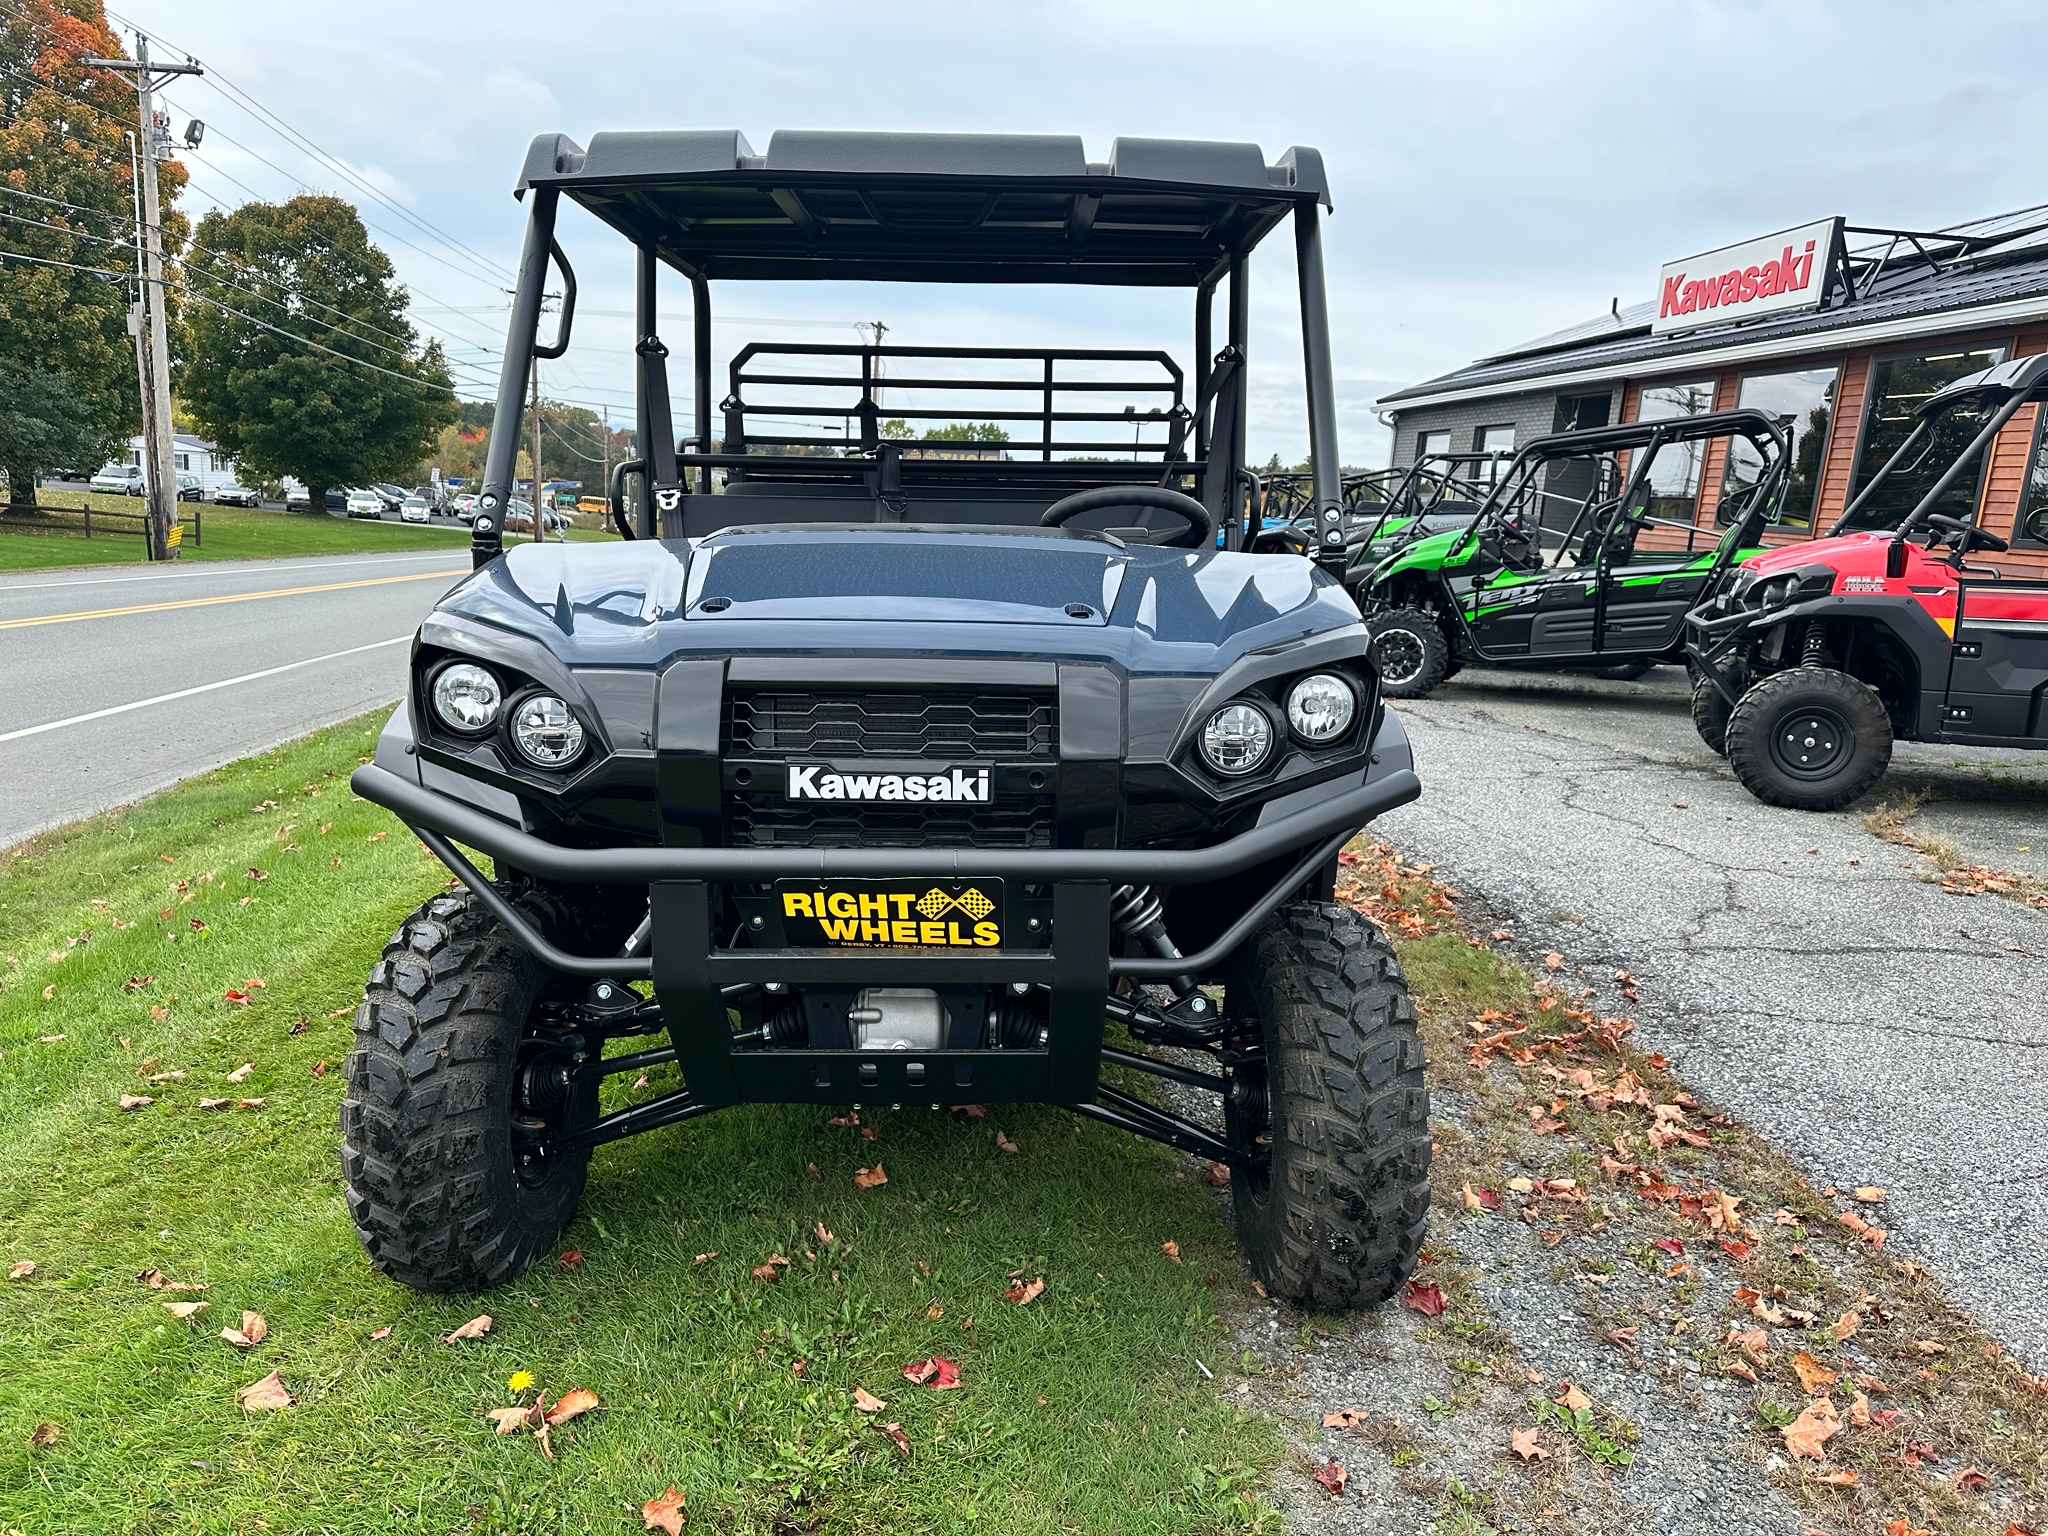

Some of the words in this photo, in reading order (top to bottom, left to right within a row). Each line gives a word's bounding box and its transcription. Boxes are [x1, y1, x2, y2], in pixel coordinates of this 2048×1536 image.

[1659, 239, 1816, 318] Kawasaki
[1352, 514, 1392, 525] Kawaski
[1432, 518, 1474, 529] Kawasa
[789, 766, 989, 801] Kawasaki
[782, 892, 916, 919] RIGHT
[819, 918, 1000, 946] WHEELS
